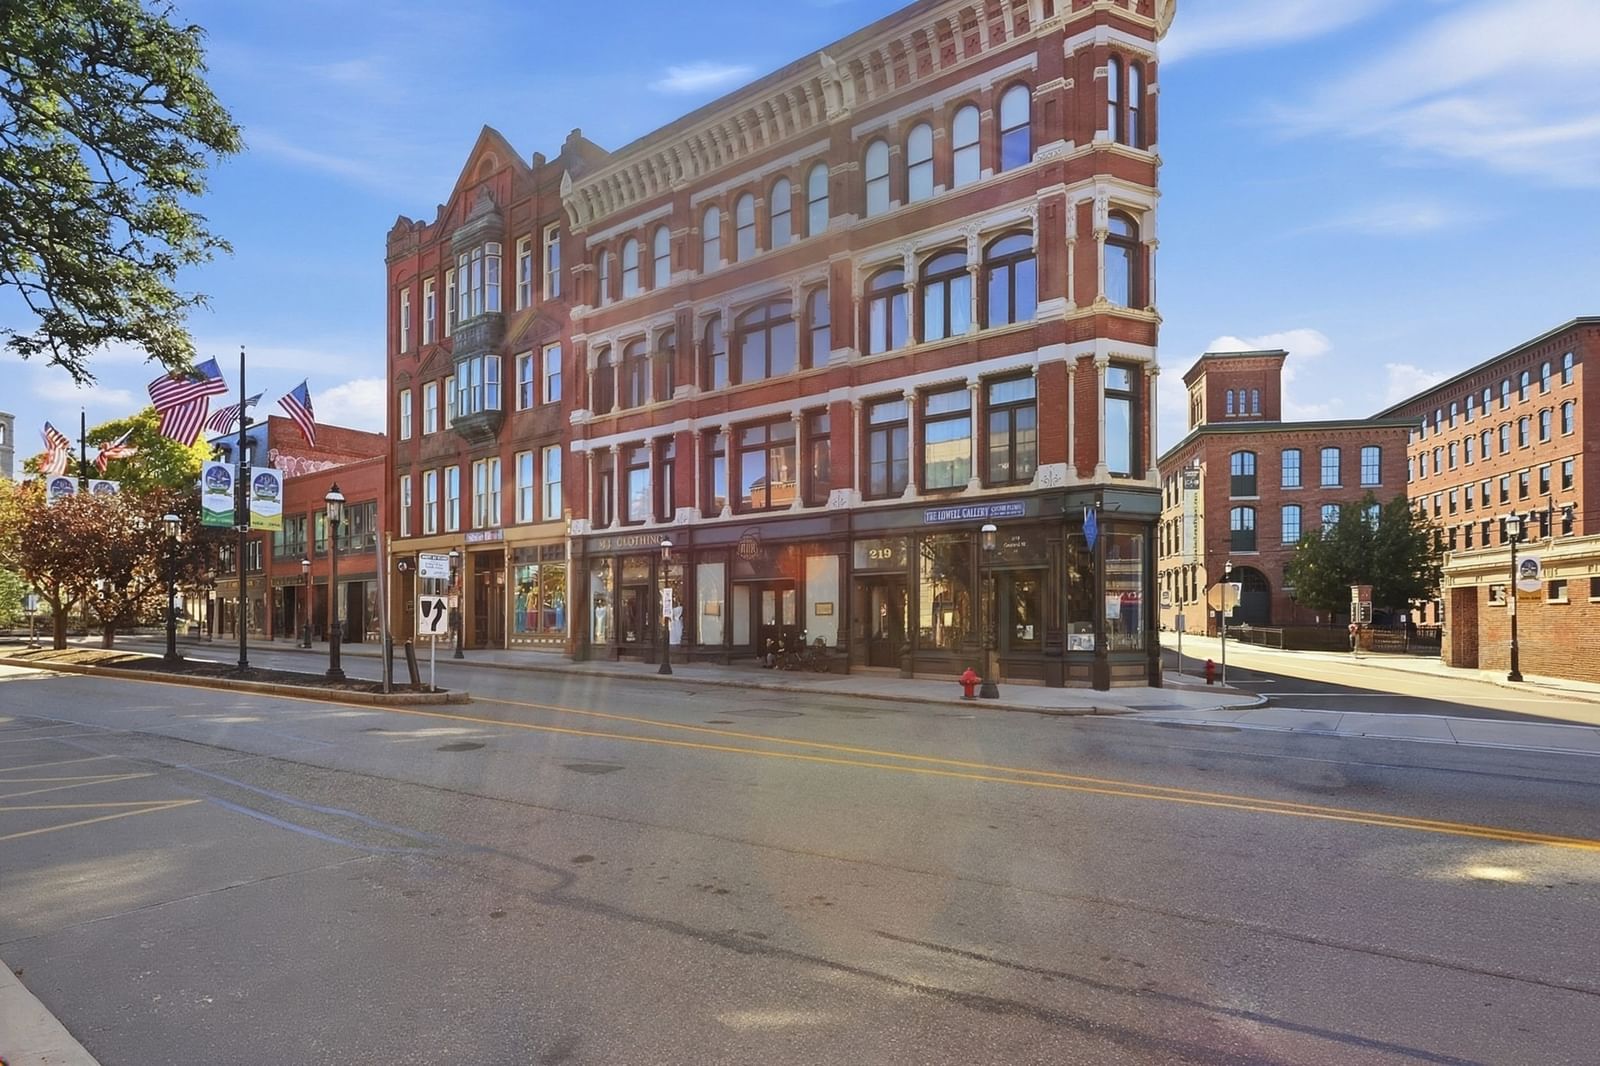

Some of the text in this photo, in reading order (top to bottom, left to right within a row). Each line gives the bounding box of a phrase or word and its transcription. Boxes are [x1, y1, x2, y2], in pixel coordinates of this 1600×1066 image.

[926, 511, 938, 522] THE
[938, 509, 961, 522] LOWELL
[962, 507, 989, 519] GALLERY
[617, 535, 663, 548] CLOTHING
[869, 548, 892, 559] 219
